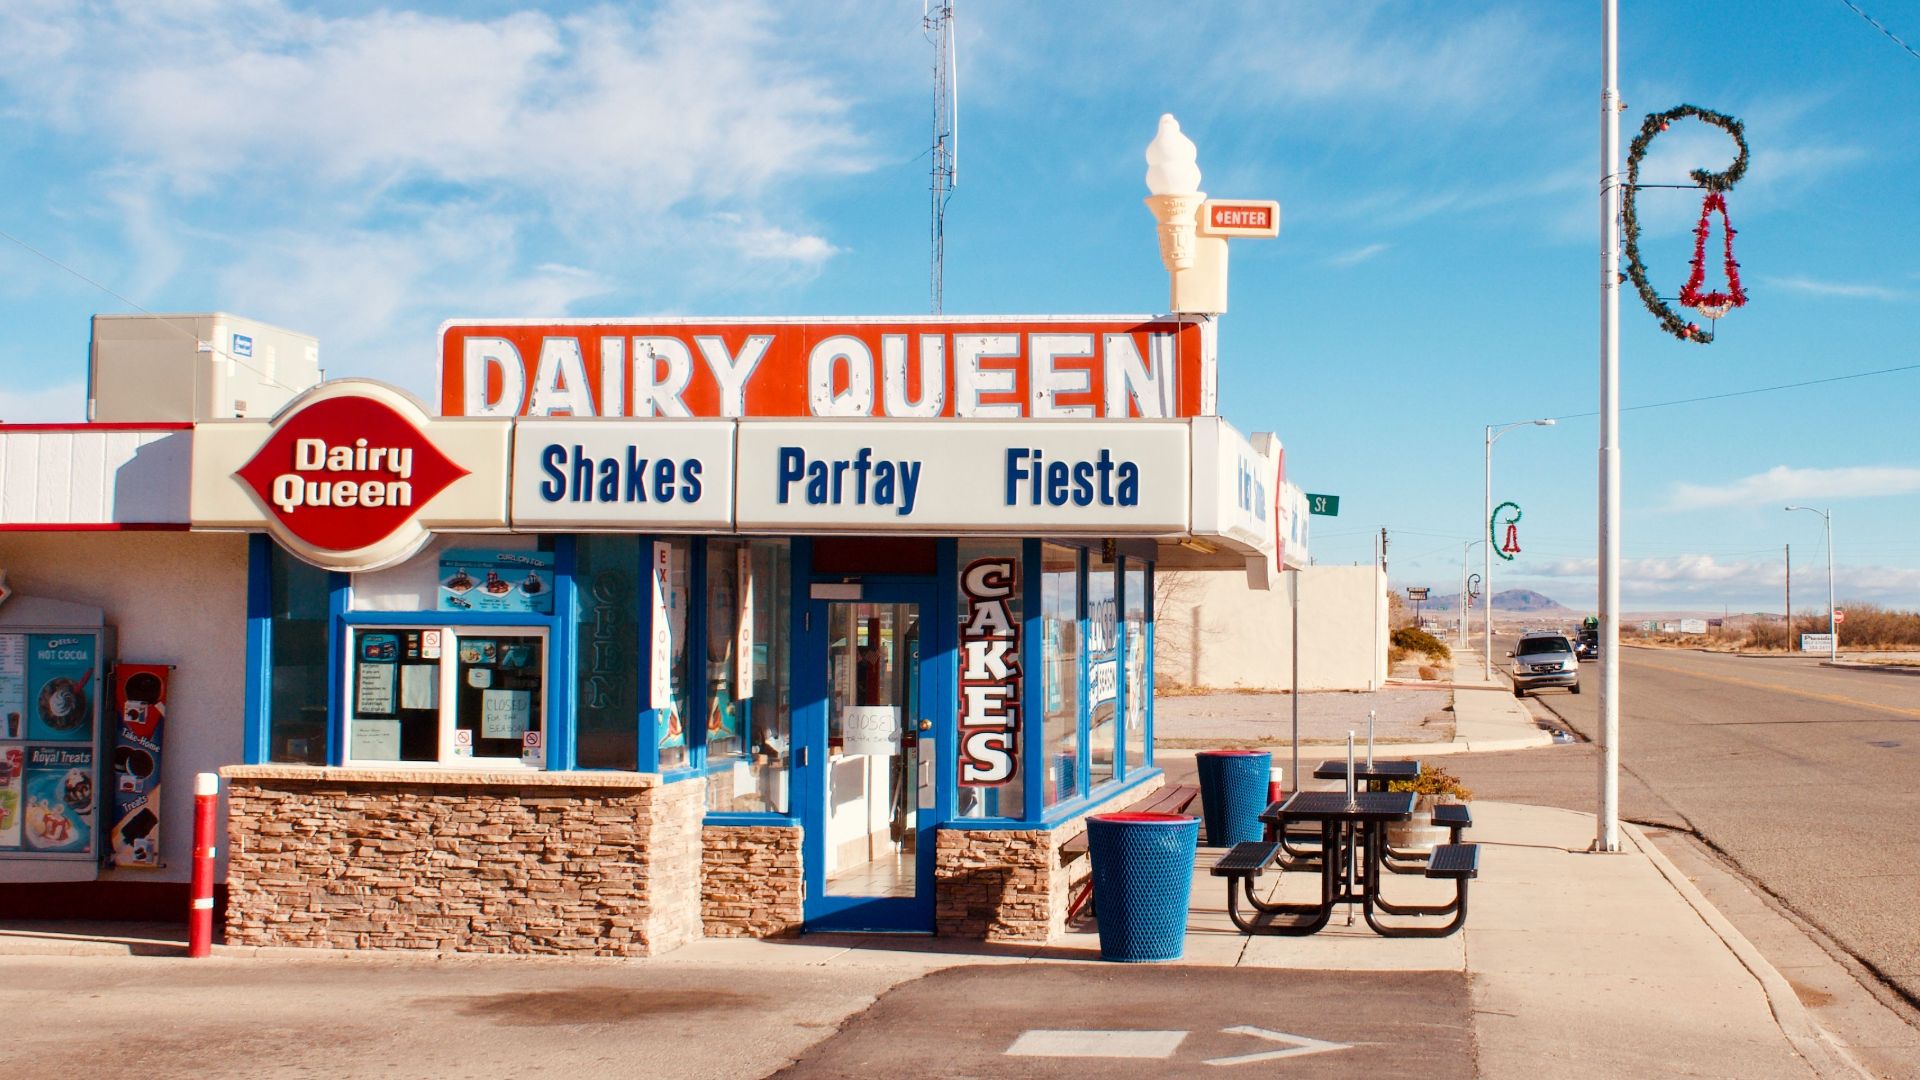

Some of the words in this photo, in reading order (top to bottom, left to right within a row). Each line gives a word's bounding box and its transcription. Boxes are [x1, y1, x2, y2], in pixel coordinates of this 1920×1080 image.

[1223, 210, 1266, 225] ENTER
[462, 332, 776, 417] DAIRY
[807, 332, 1177, 417] QUEEN
[295, 438, 412, 479] Dairy
[541, 442, 703, 504] Shakes
[272, 474, 412, 513] Queen
[779, 446, 922, 516] Parfay
[1006, 447, 1140, 507] Fiesta
[1314, 496, 1327, 513] St
[659, 550, 667, 621] EXIT
[38, 650, 56, 660] HOT
[57, 650, 88, 661] COCOA
[658, 630, 666, 696] ONLY
[960, 560, 1020, 786] CAKES
[486, 698, 528, 712] CLOSED
[122, 727, 160, 752] Take-Home
[489, 724, 525, 733] SEASON
[32, 750, 60, 766] Royal
[61, 750, 91, 763] Treats
[122, 794, 149, 812] Treats
